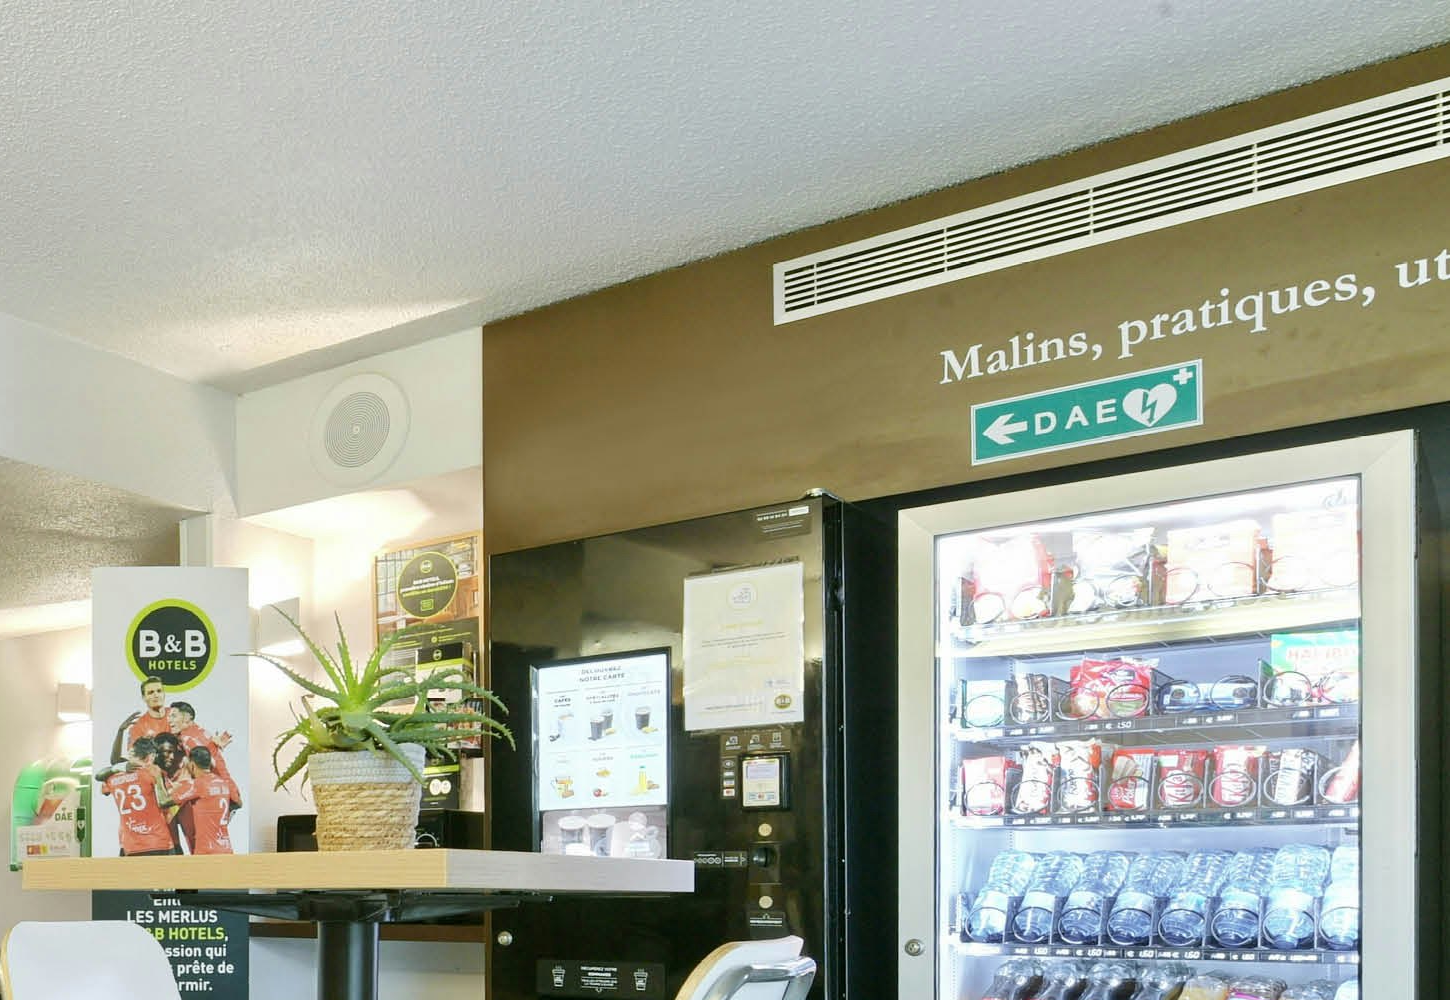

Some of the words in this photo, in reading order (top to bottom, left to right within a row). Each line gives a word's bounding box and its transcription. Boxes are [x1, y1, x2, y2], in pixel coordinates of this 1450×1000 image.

[939, 331, 1102, 385] Malins,
[1117, 273, 1376, 359] pratiques,
[1034, 399, 1117, 436] DAE
[139, 629, 207, 658] B&B
[148, 660, 197, 671] HOTELS
[112, 784, 147, 816] 23
[54, 812, 73, 822] DAE
[127, 910, 154, 923] LES
[158, 910, 218, 923] MERLUS
[169, 927, 229, 941] HOTELS,
[165, 945, 201, 957] ssion
[205, 945, 227, 959] qui
[177, 962, 215, 976] prête
[218, 963, 234, 974] de
